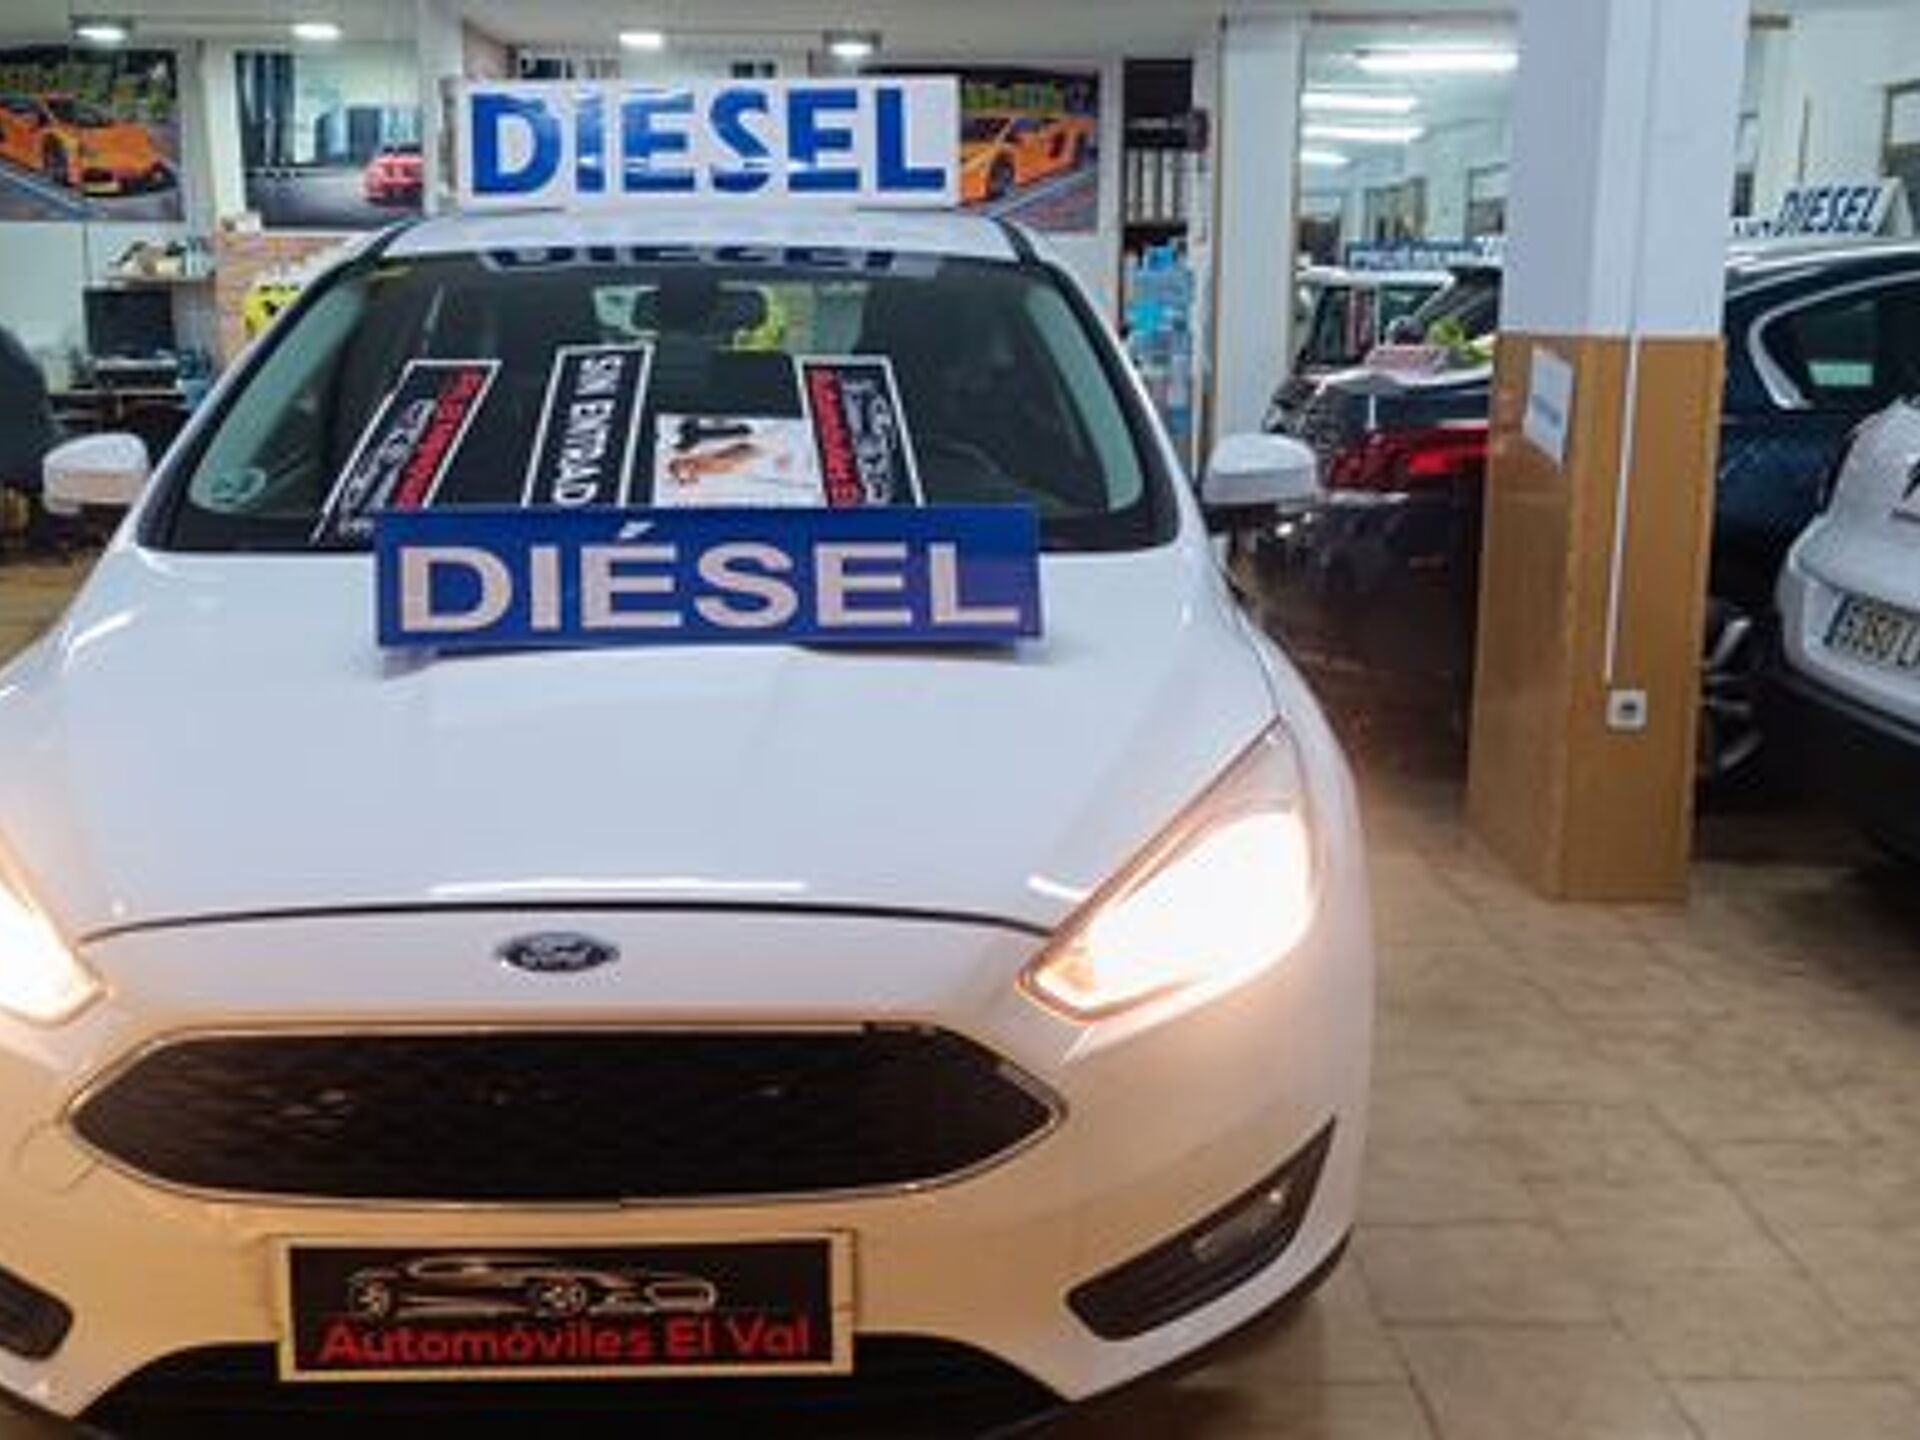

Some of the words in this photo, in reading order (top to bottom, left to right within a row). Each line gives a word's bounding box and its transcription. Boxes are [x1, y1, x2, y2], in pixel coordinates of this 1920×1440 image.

[471, 86, 947, 194] DIESEL
[1780, 186, 1882, 236] DIESEL
[576, 355, 624, 396] SIN
[399, 522, 1020, 632] DIÉSEL
[320, 1318, 651, 1363] Automóviles
[664, 1318, 712, 1360] El
[726, 1315, 809, 1358] Val
